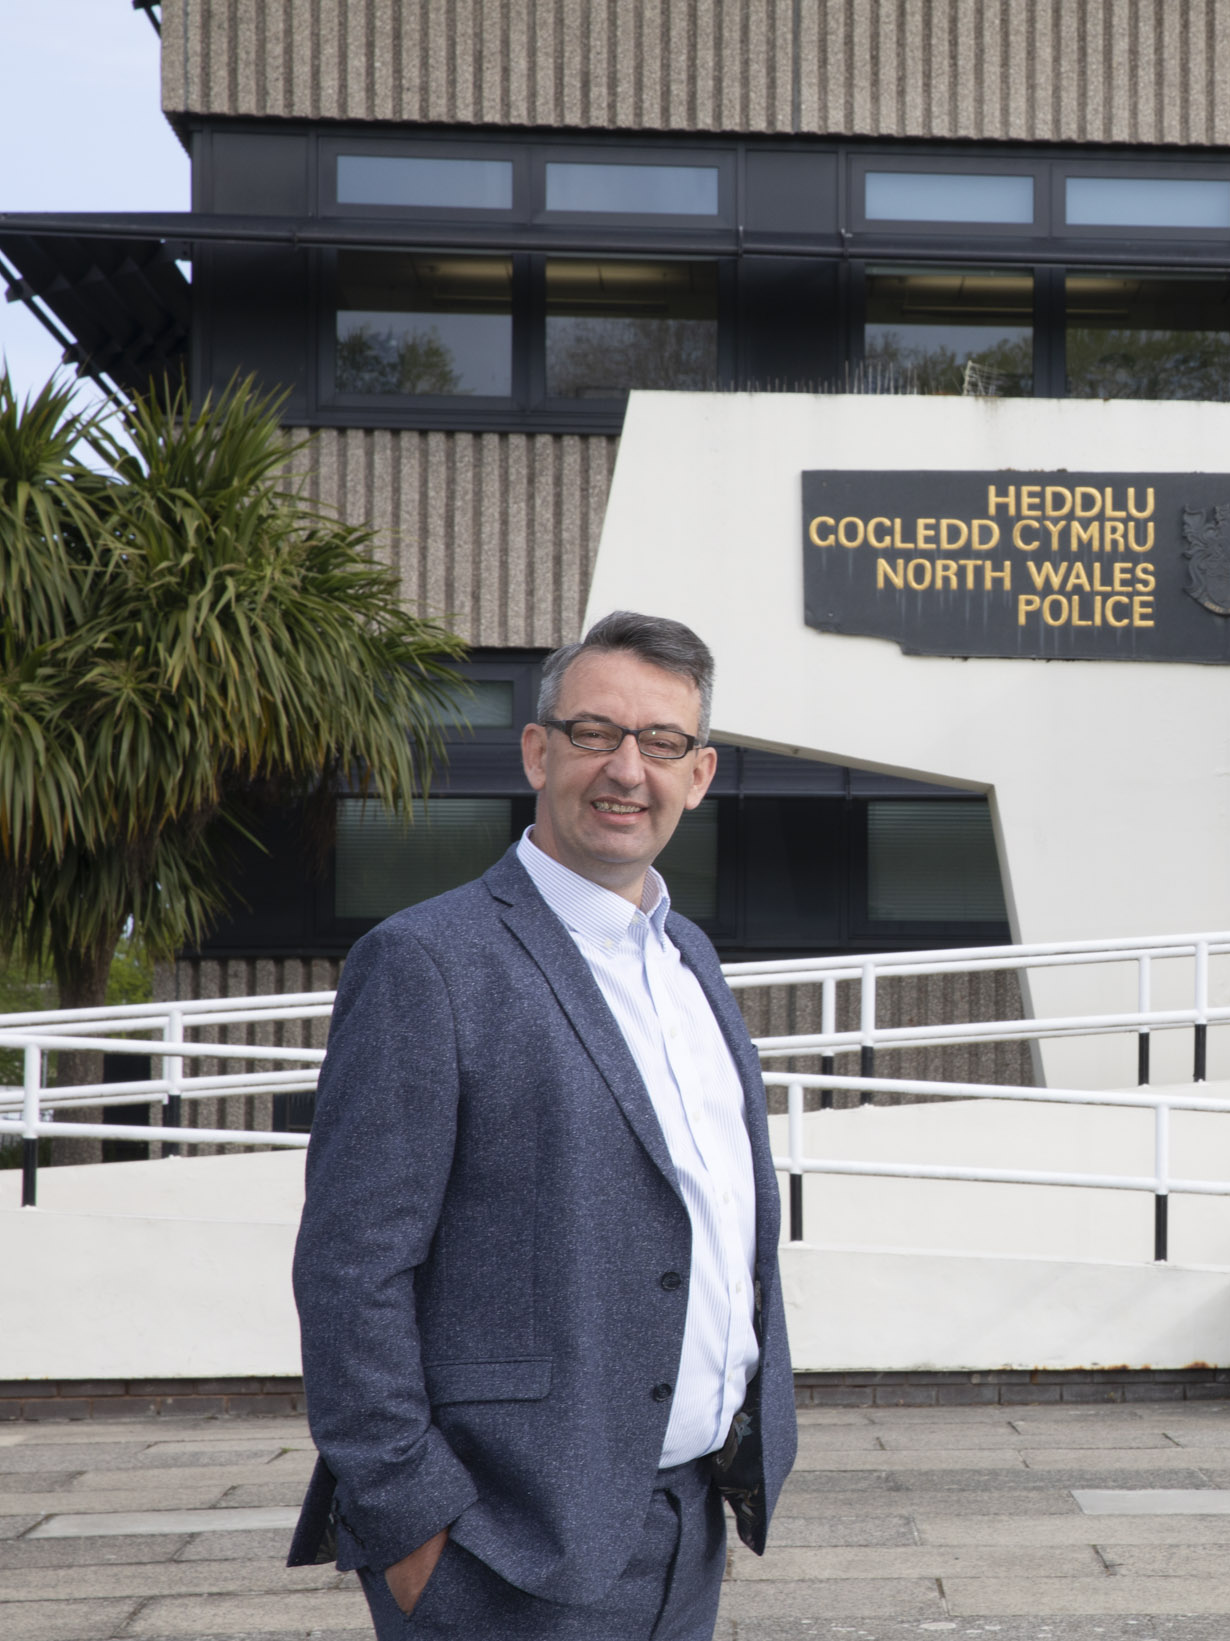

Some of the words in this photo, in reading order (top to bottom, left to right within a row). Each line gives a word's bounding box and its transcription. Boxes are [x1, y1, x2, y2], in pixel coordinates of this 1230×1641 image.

[988, 485, 1155, 519] HEDDLU
[809, 516, 1001, 551] GOGLEDD
[1012, 520, 1155, 553] CYMRU
[876, 558, 1012, 591] NORTH
[1026, 561, 1156, 593] WALES
[1017, 594, 1156, 628] POLICE
